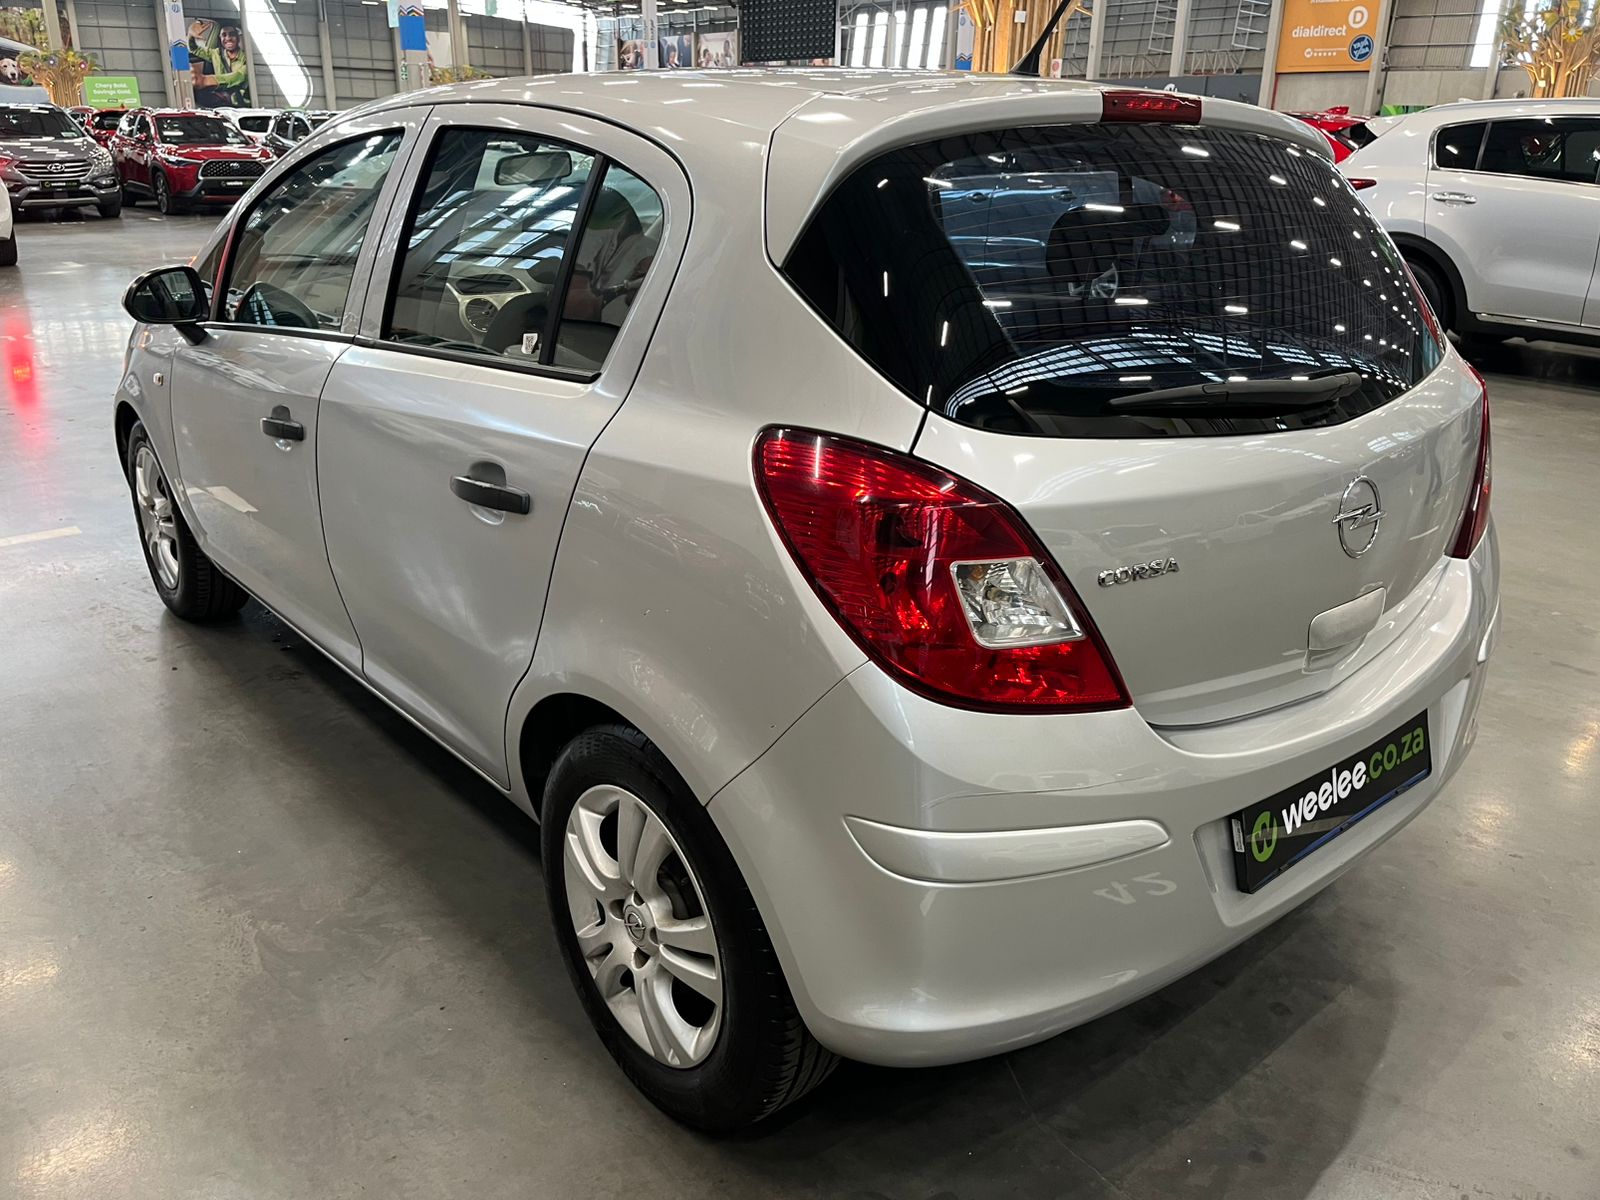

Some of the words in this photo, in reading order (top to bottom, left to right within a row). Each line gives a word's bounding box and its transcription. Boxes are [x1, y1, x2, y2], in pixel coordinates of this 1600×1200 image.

[1292, 25, 1347, 38] dialdirect
[1098, 557, 1179, 587] CORSA
[1281, 727, 1425, 835] weelee.co.za
